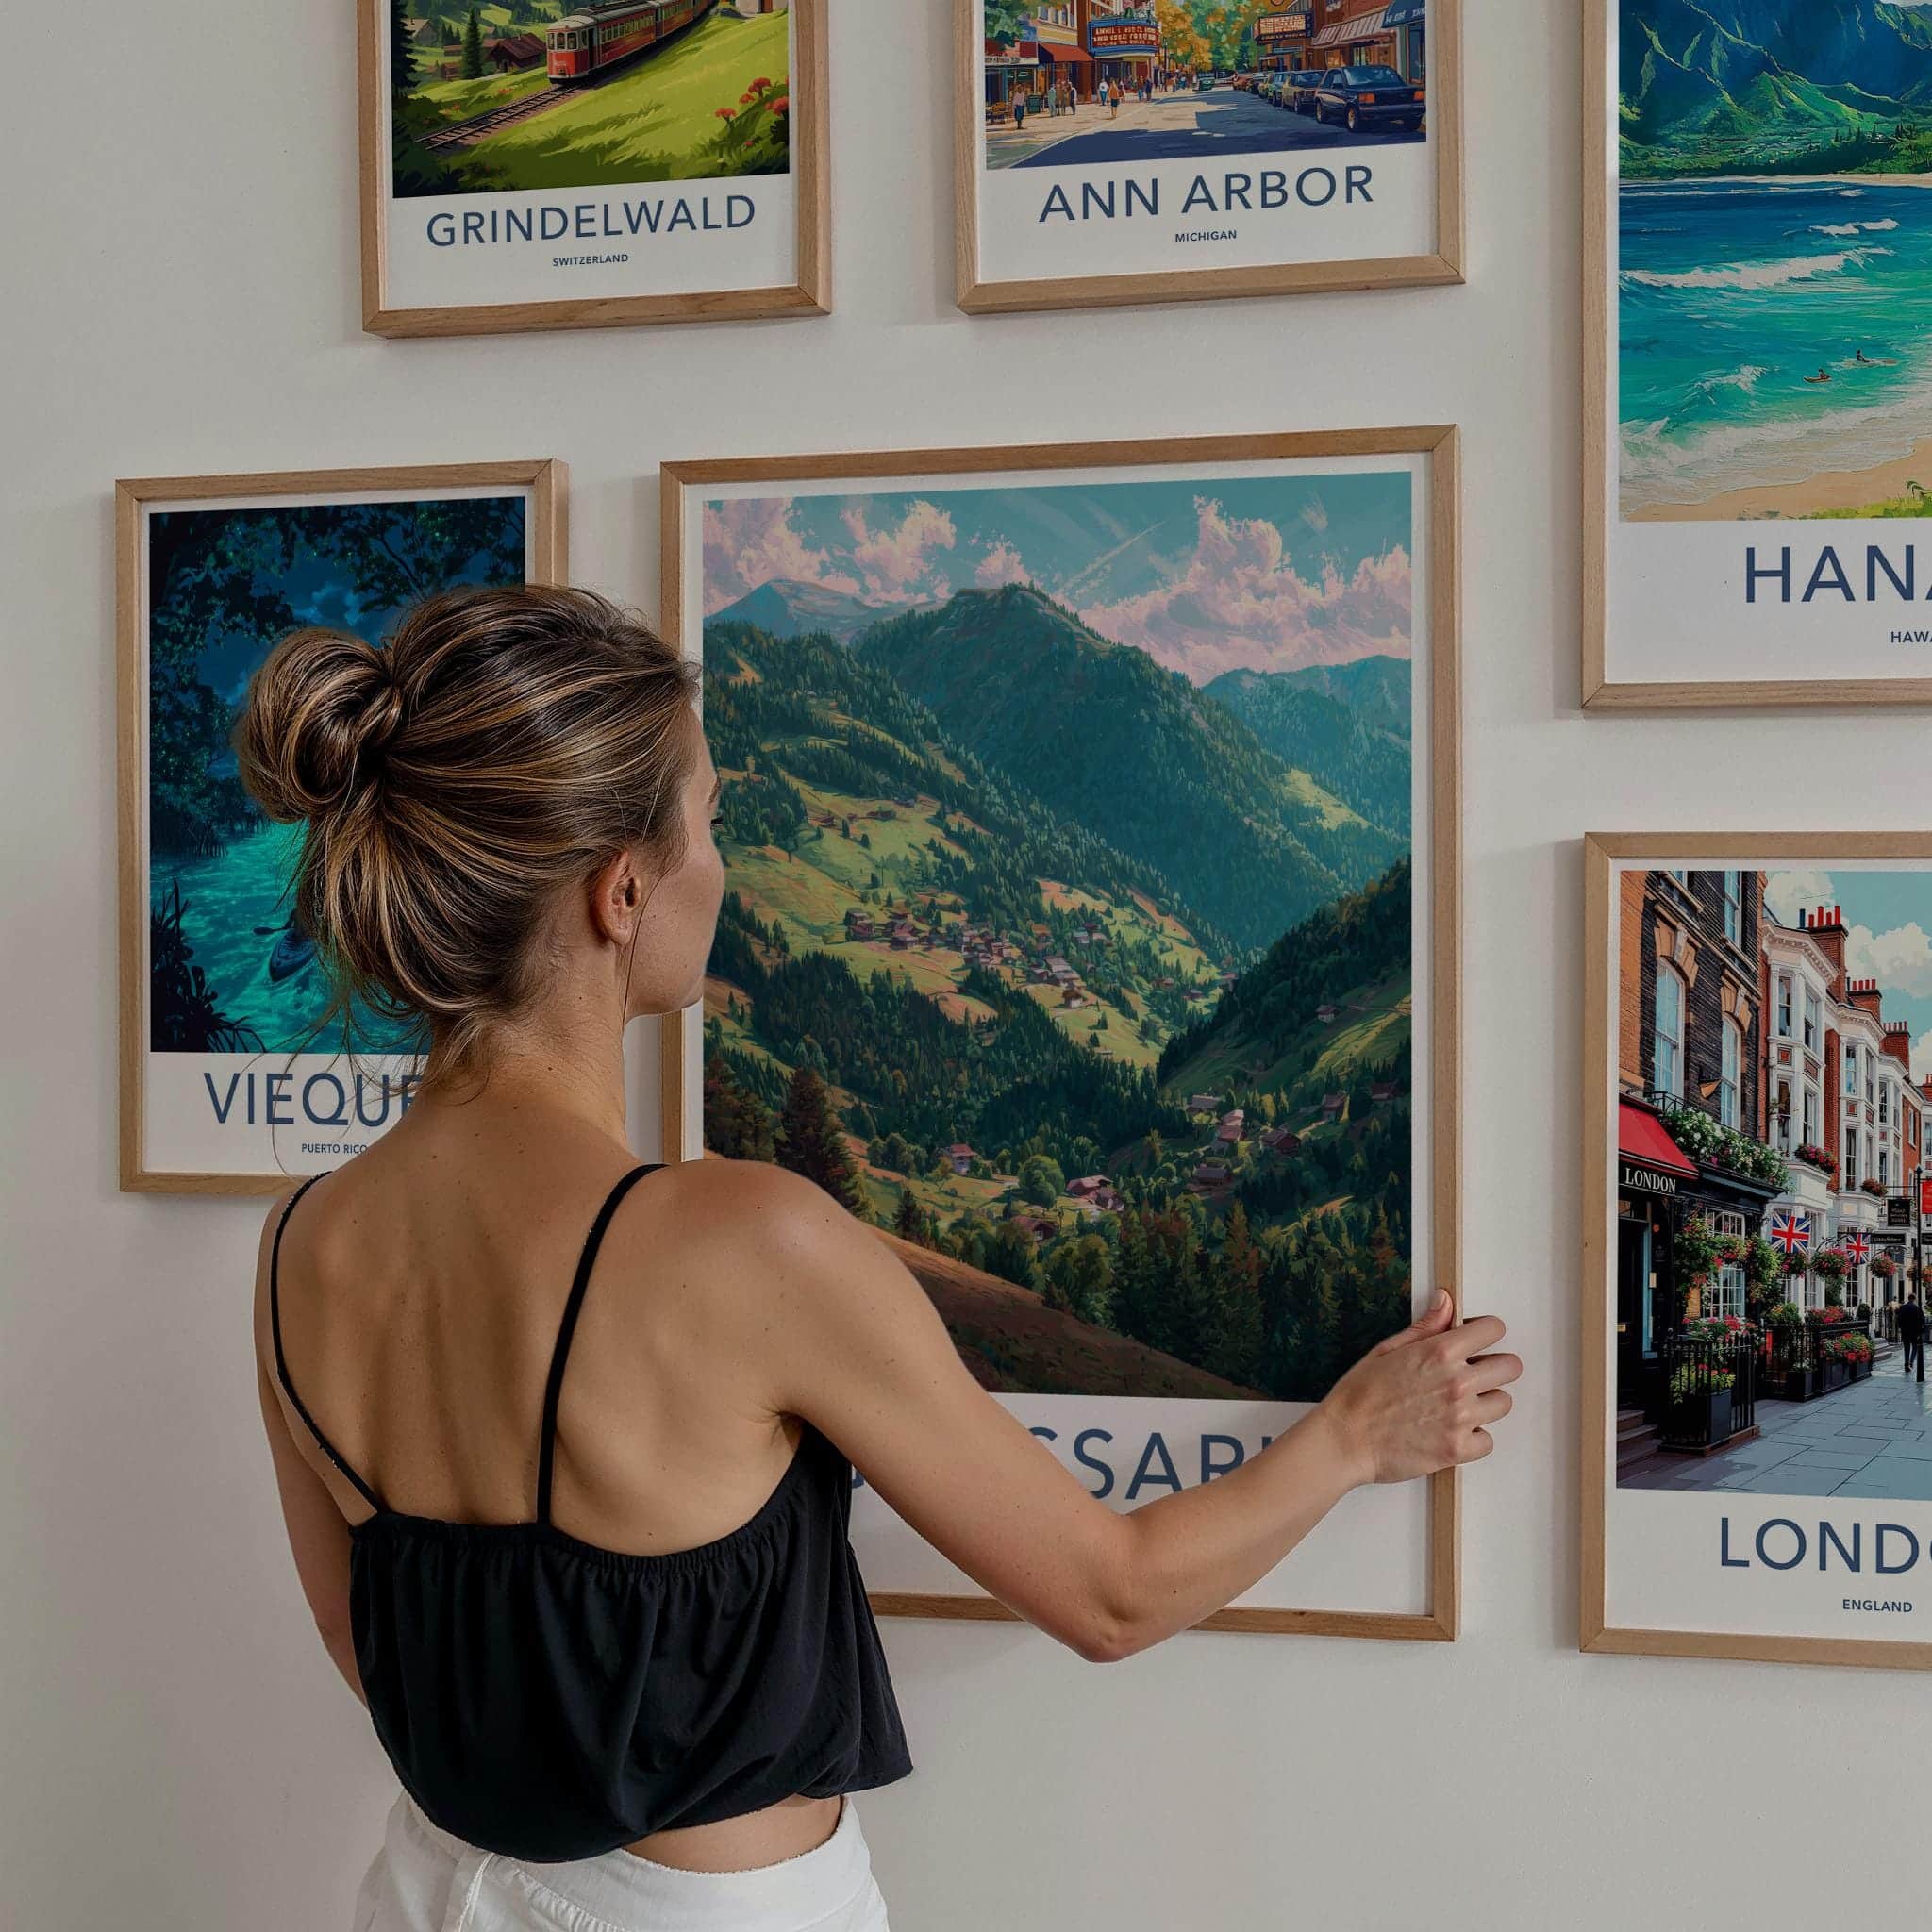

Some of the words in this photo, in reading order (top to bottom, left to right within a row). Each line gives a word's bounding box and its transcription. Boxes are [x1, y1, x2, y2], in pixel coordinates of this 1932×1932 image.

[1039, 178, 1158, 223] ANN
[1182, 165, 1374, 213] ARBOR
[426, 194, 756, 248] GRINDELWALD
[1174, 229, 1237, 242] MICHIGAN
[552, 254, 629, 267] SWITZERLAND
[1746, 545, 1932, 603] HAN
[1890, 630, 1932, 643] HAW
[301, 1143, 341, 1154] PUERTO
[343, 1144, 368, 1154] RICO
[1624, 1167, 1676, 1194] LONDON
[1721, 1517, 1932, 1574] LOND
[1842, 1599, 1913, 1613] ENGLAND
